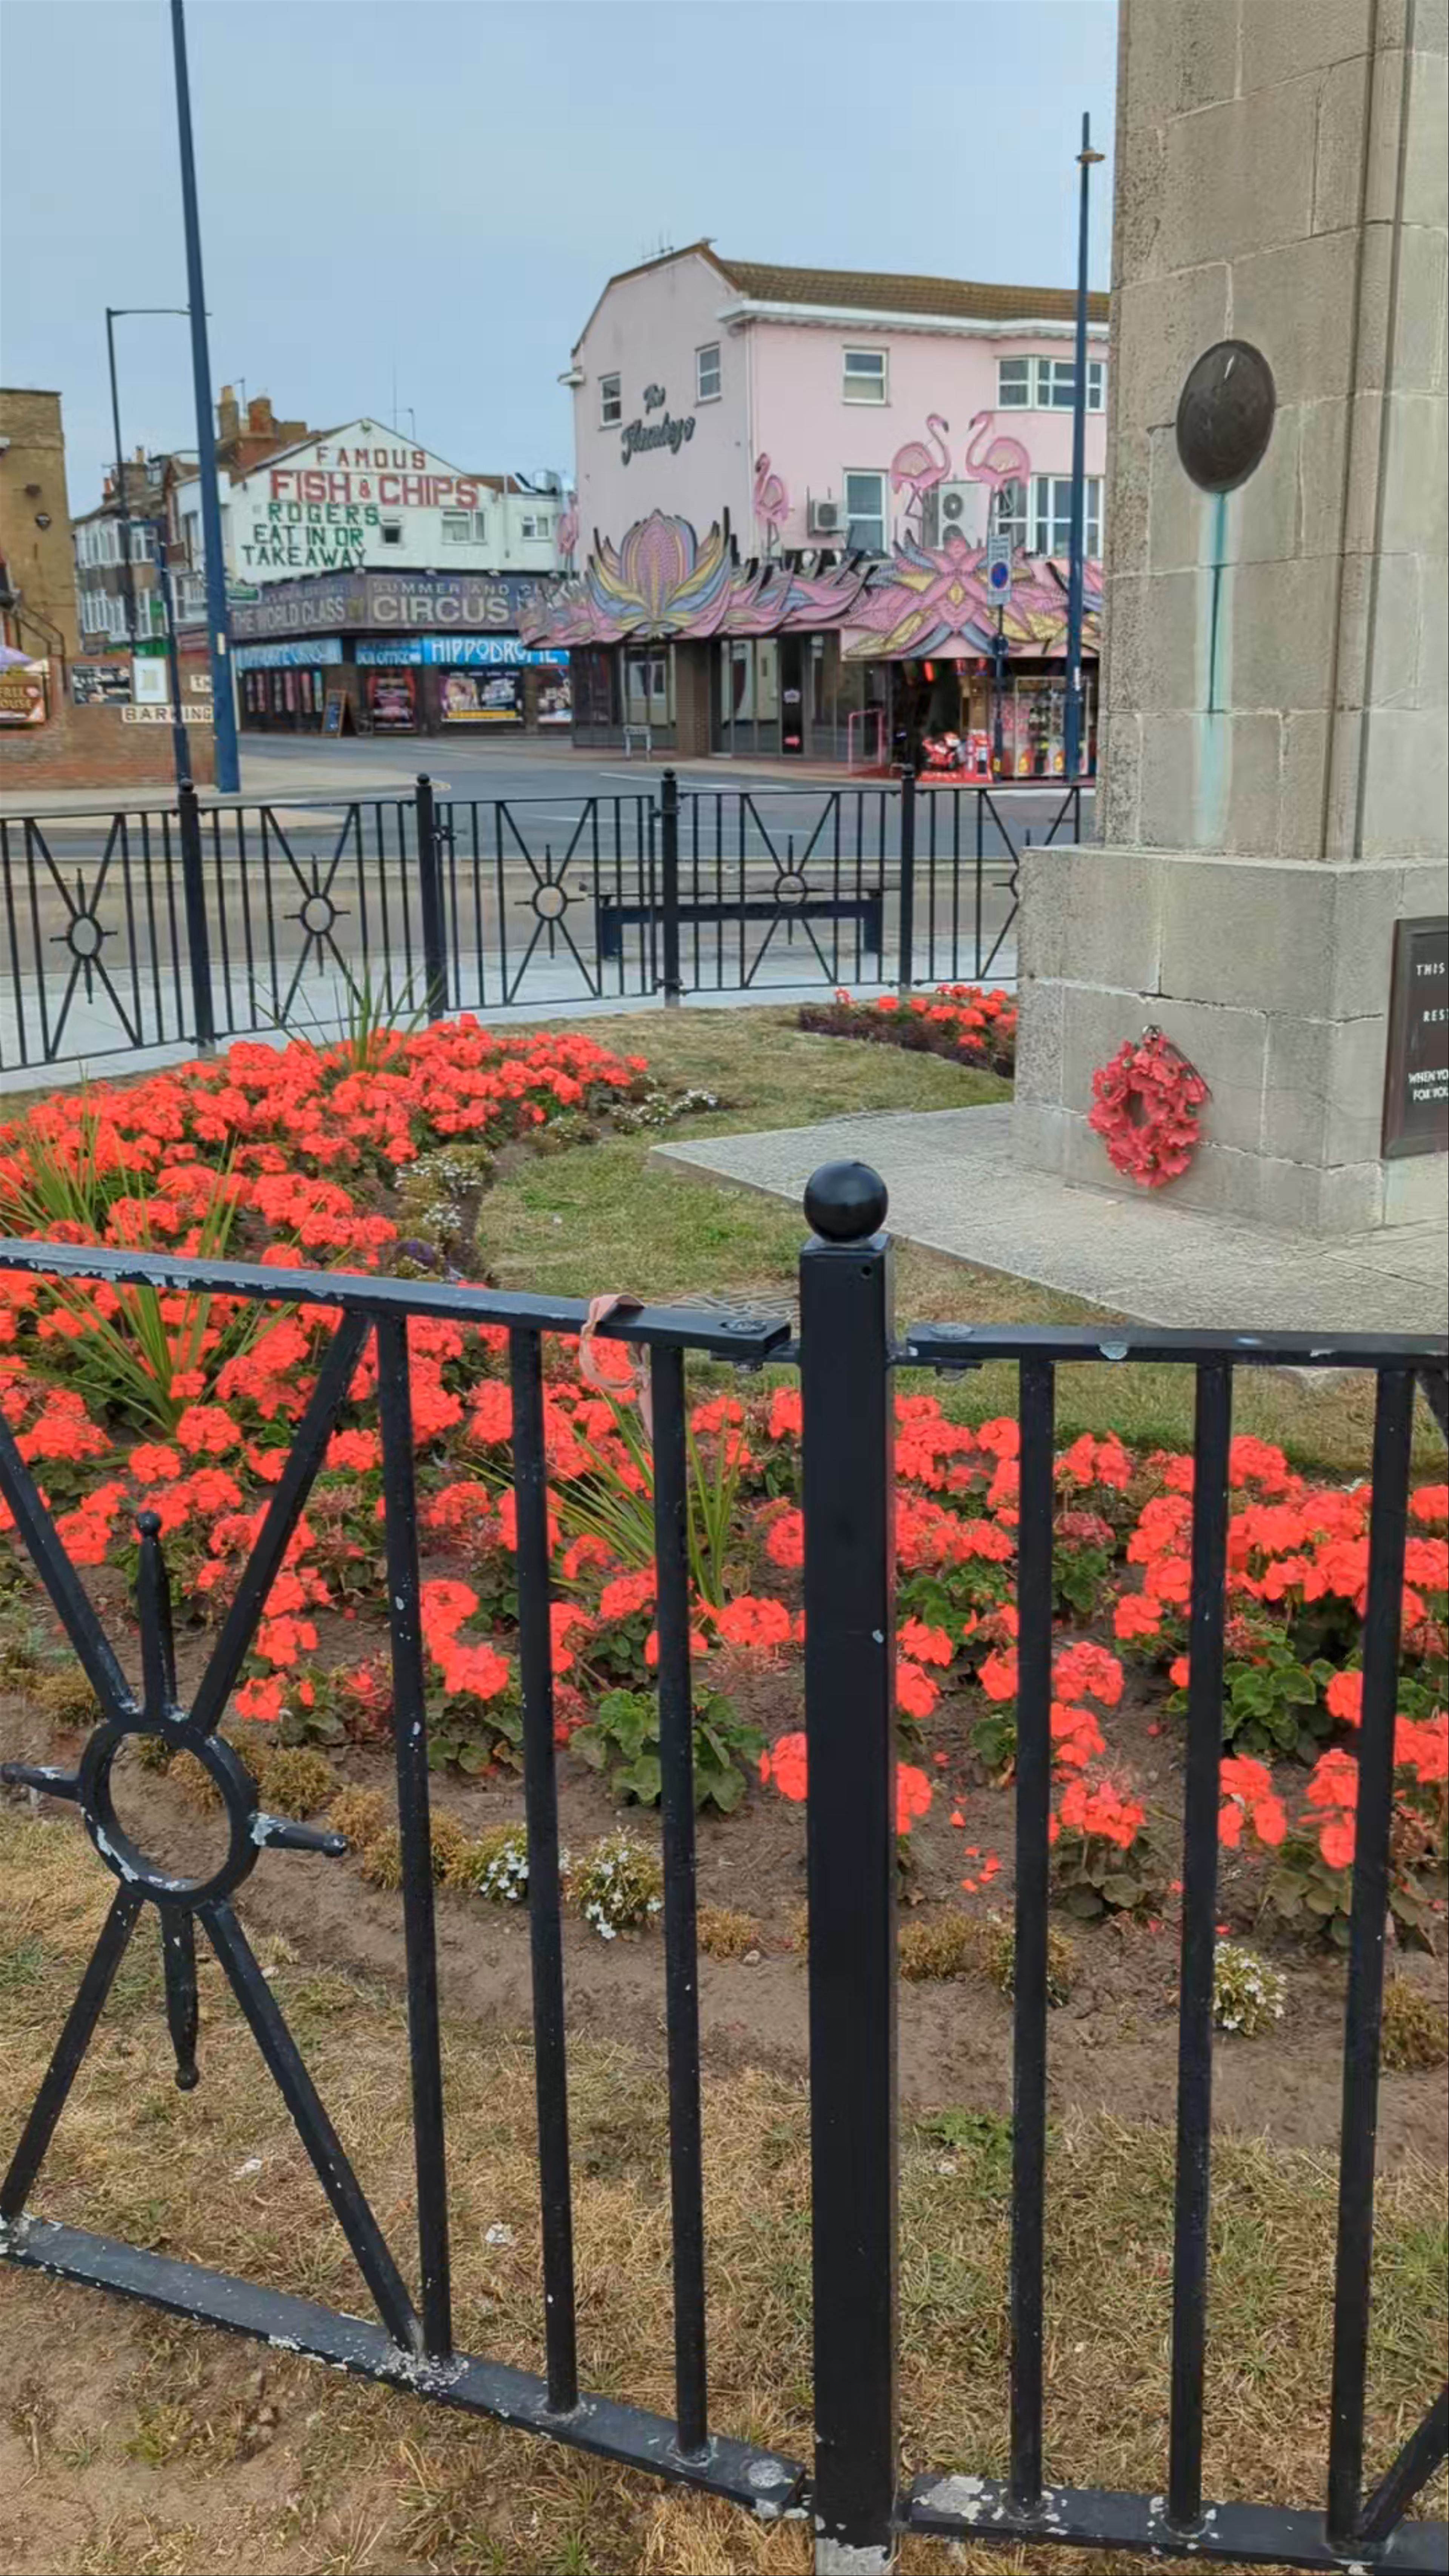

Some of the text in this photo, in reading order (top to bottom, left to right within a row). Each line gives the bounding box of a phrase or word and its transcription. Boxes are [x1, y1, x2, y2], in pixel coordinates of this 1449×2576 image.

[315, 446, 426, 470] FAMOUS
[270, 469, 478, 509] FISH & CHIPS
[268, 503, 380, 527] ROGERS
[253, 524, 364, 547] EAT IN OR
[240, 545, 366, 568] TAKEAWAY
[373, 581, 460, 595] SUMMER
[470, 584, 509, 596] AND
[302, 595, 345, 625] CLASS
[373, 595, 509, 623] CIRCUS
[126, 707, 212, 720] BARING
[1416, 962, 1445, 977] THIS
[1408, 1071, 1435, 1083] WHEN
